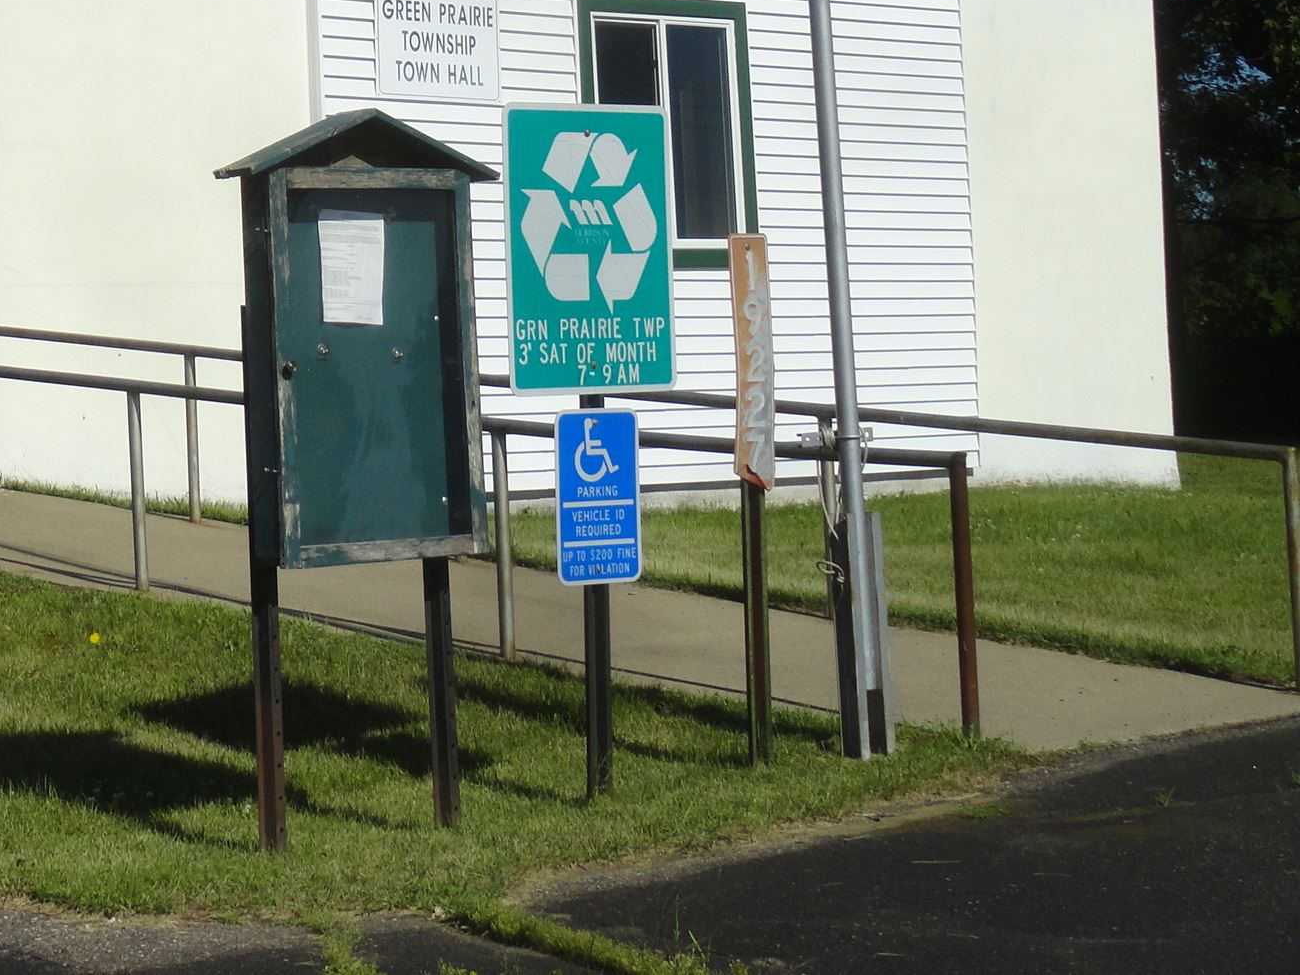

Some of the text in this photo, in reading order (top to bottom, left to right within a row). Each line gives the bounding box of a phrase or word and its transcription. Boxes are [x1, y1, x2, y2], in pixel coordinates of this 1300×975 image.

[439, 3, 493, 28] PRAIRIE
[401, 30, 477, 56] TOWNSHIP
[395, 60, 484, 86] TOWN HALL
[516, 317, 665, 341] GRN PRAIRIE TWP
[540, 343, 568, 364] SAT
[577, 343, 596, 364] OF
[605, 341, 657, 363] MONTH
[577, 485, 618, 498] PARKING
[572, 509, 625, 522] VEHICLE ID
[575, 523, 622, 537] REQUIRED
[562, 551, 573, 563] UP
[576, 550, 586, 562] TO
[617, 547, 637, 560] FINE
[570, 565, 585, 577] FOR
